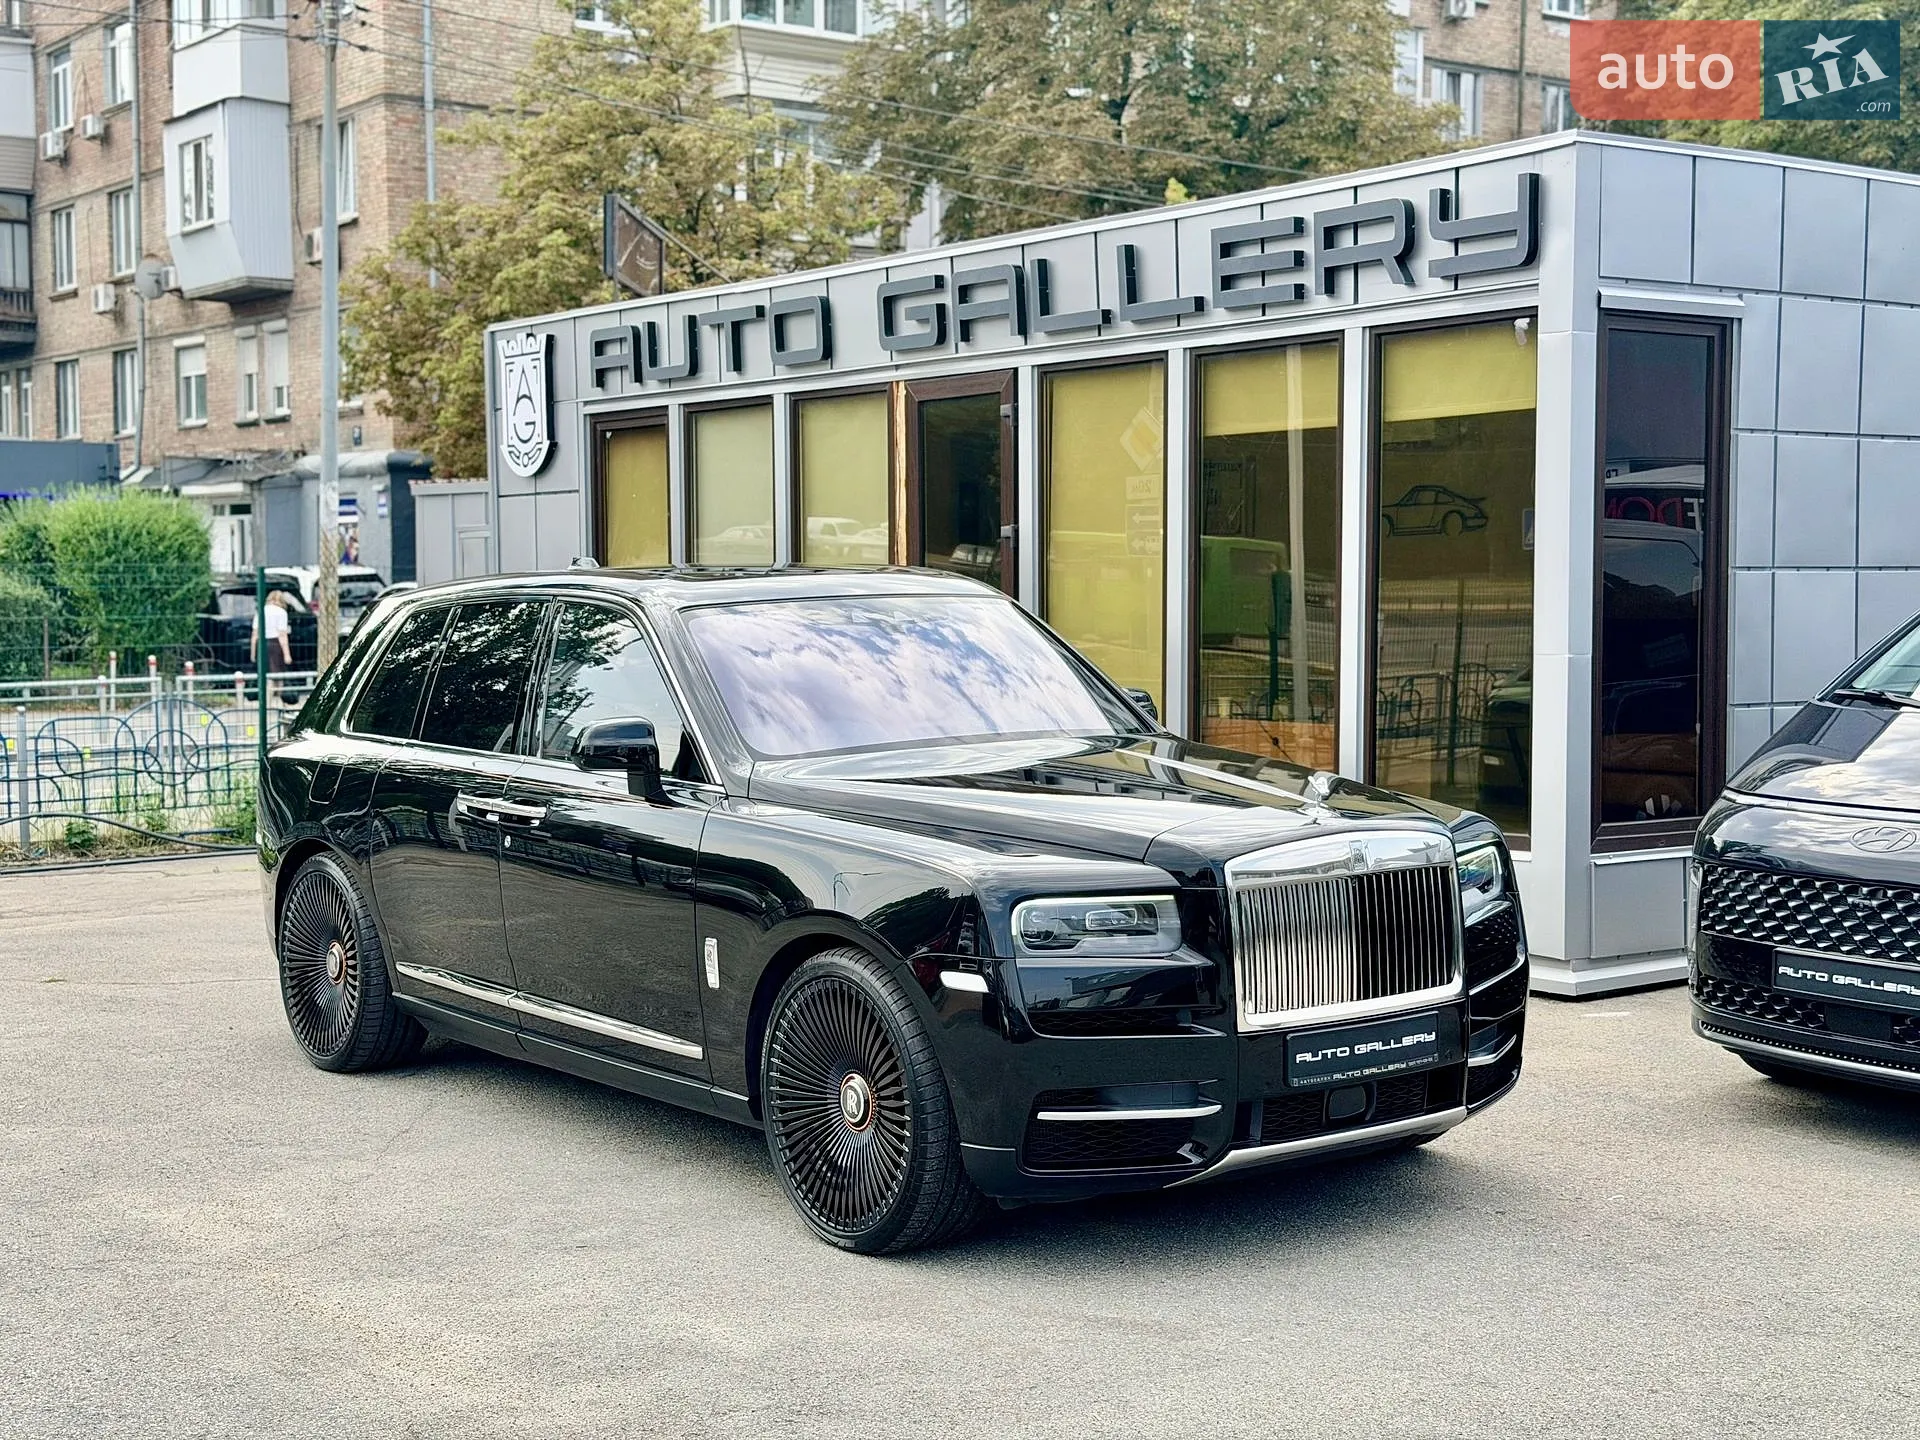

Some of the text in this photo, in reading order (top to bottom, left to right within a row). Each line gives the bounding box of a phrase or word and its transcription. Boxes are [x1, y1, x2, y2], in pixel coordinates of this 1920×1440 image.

[590, 172, 1540, 388] AUTO GALLERY
[1778, 966, 1828, 982] AUTO
[1295, 1031, 1436, 1064] AUTO GALLERY
[1332, 1070, 1361, 1080] AUTO
[1362, 1062, 1407, 1076] GALLERY
